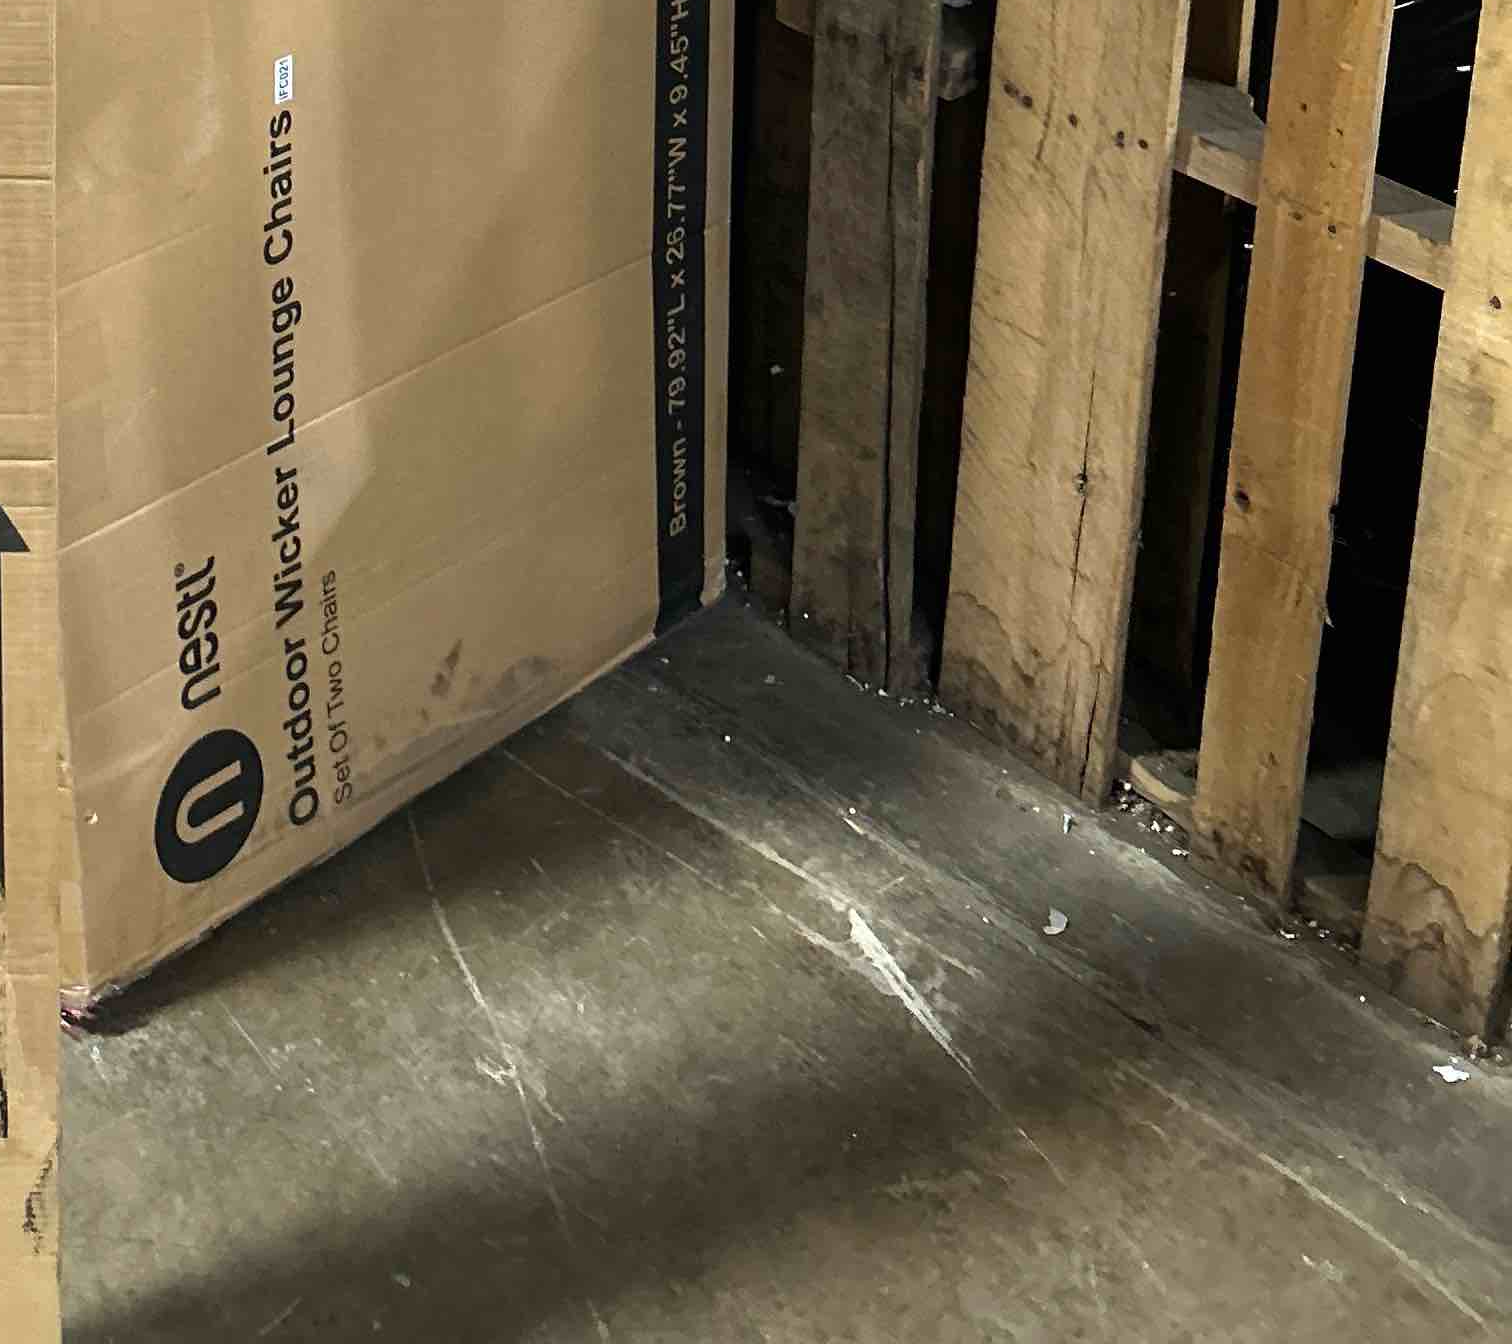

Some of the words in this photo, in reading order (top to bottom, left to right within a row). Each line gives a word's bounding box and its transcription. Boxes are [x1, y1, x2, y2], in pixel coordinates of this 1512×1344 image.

[672, 108, 687, 128] x
[262, 109, 293, 268] Chairs
[665, 136, 688, 265] 26.77"W
[670, 268, 684, 289] x
[266, 275, 302, 456] Lounge
[668, 436, 688, 537] Brown
[272, 465, 306, 630] Wicker
[321, 569, 341, 654] Chairs
[282, 637, 320, 826] Outdoor
[326, 658, 346, 720] Two
[331, 723, 350, 756] Of
[334, 755, 354, 806] Set
